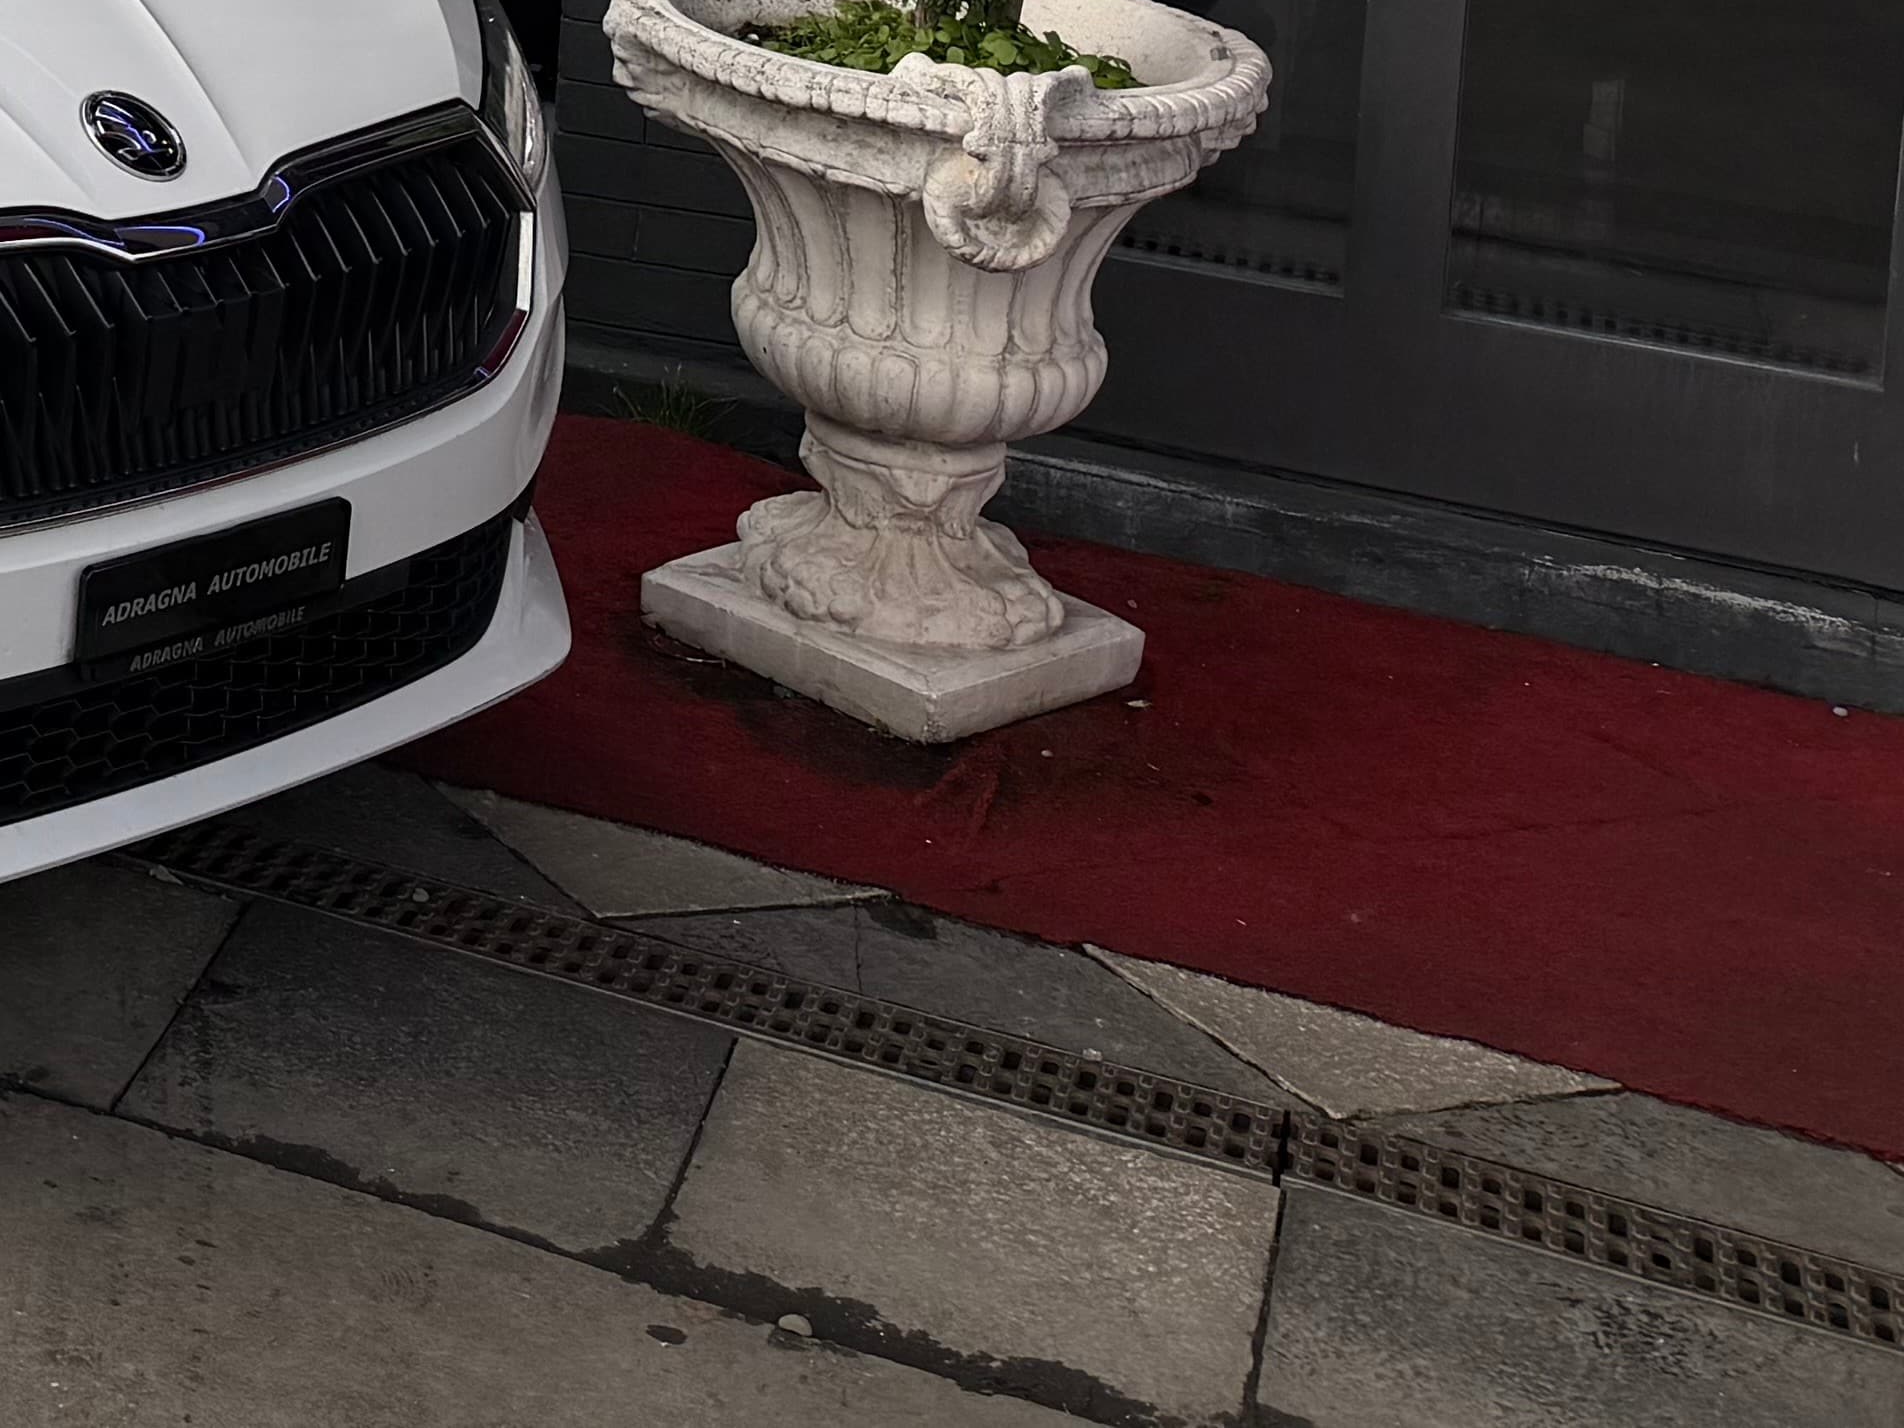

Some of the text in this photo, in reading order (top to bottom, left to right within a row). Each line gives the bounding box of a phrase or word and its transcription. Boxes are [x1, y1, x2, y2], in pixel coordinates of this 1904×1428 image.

[102, 542, 332, 626] ADRAGNA AUTOMOBILE
[129, 606, 306, 672] ADRAGNA AUTOMOBILE
